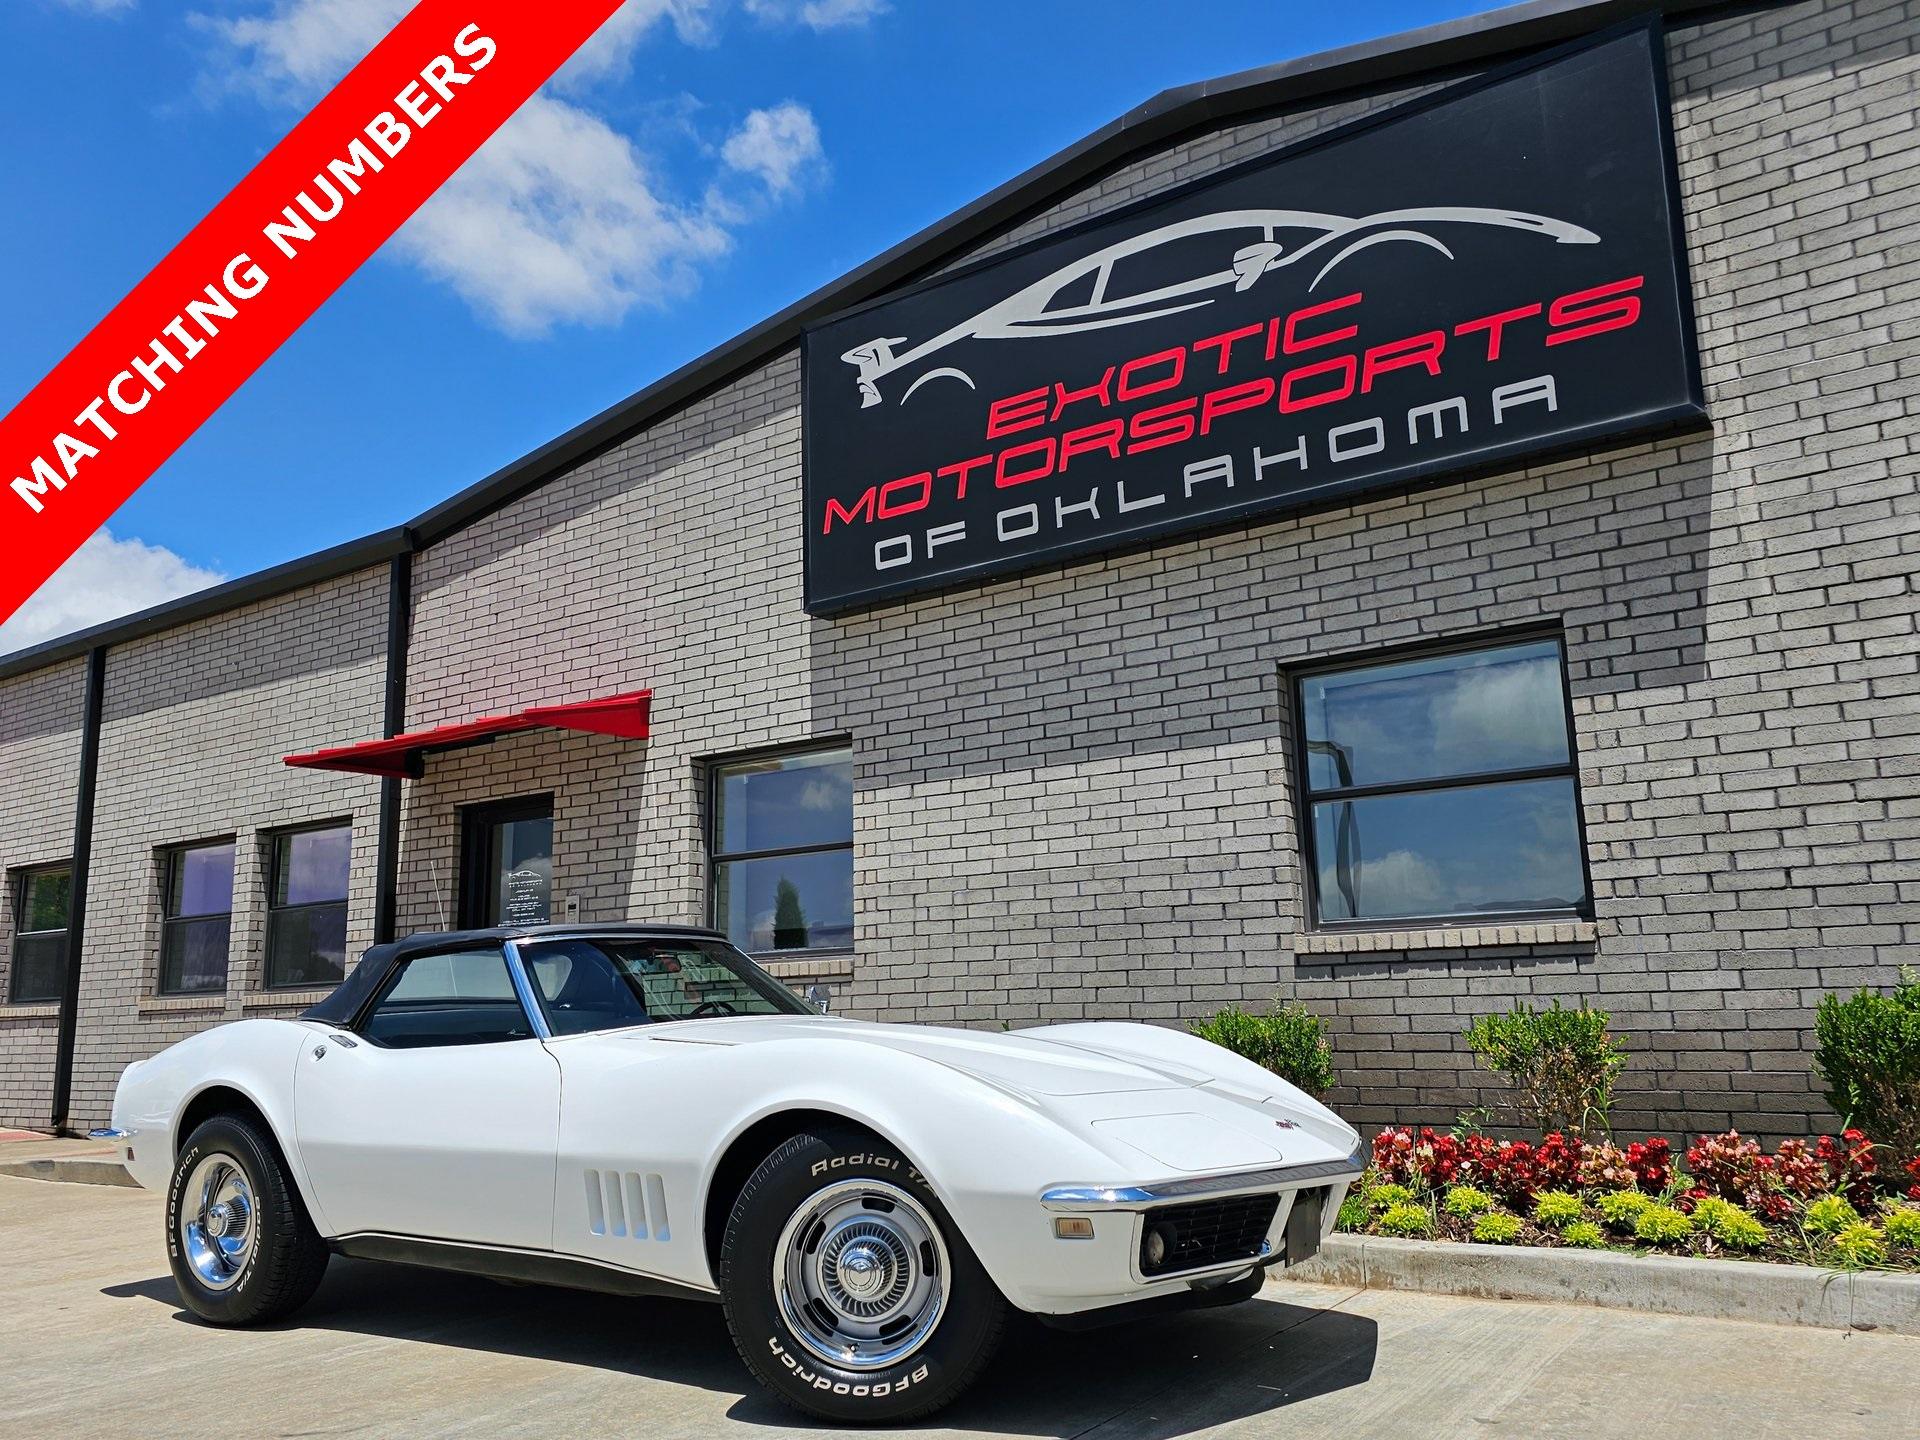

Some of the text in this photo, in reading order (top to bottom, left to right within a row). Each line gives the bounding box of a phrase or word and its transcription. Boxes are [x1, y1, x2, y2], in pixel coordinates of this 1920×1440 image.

[823, 275, 1645, 534] MOTORSPORTS
[986, 292, 1362, 440] EXOTIC
[874, 374, 1558, 572] OF OKLAHOMA
[168, 1146, 199, 1257] BFGoodrich
[811, 1152, 900, 1177] Radial
[768, 1336, 929, 1398] BFGoodrich
